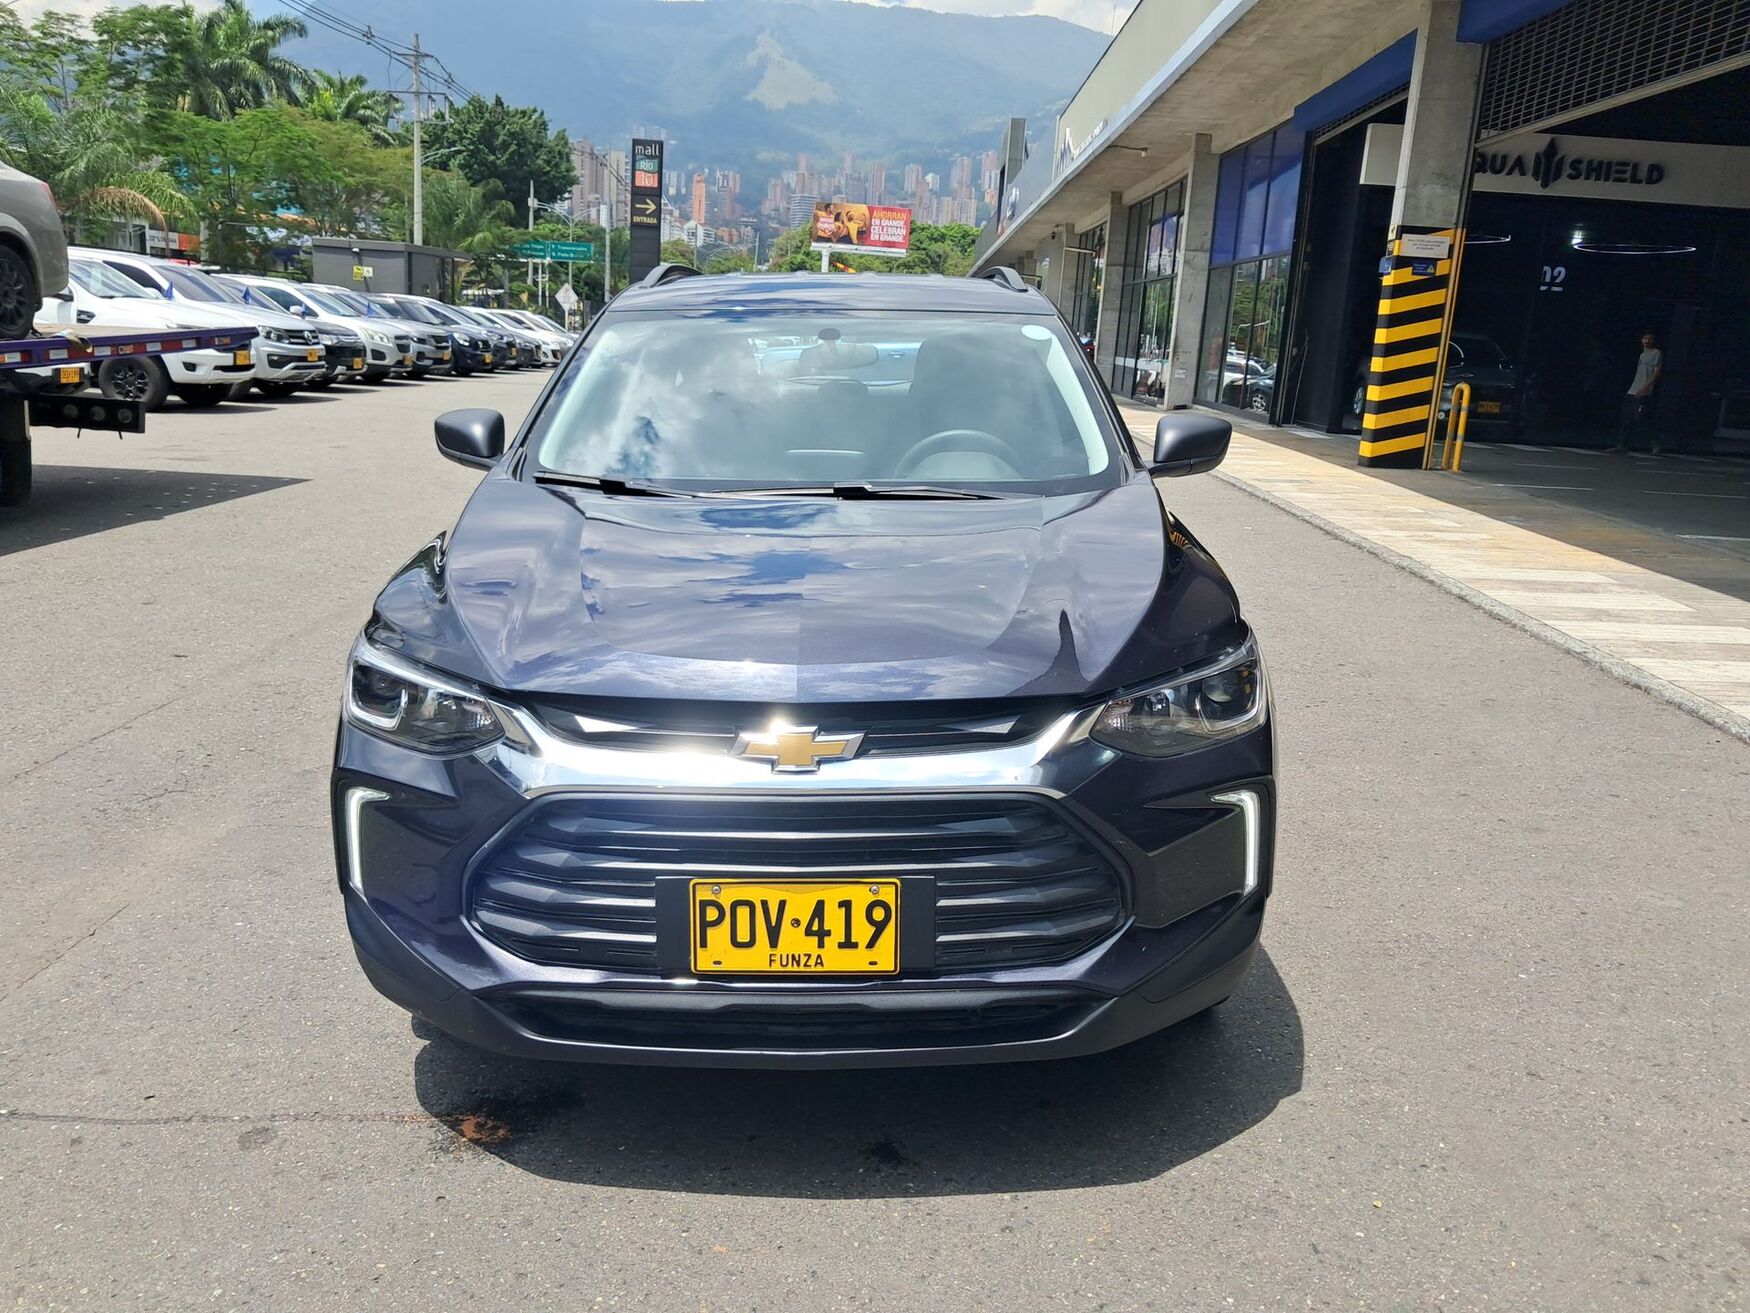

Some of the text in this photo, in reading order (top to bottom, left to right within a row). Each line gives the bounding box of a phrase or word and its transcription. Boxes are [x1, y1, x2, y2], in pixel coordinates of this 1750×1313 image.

[635, 144, 659, 156] mall
[1566, 158, 1665, 185] SHIELD
[633, 215, 658, 224] ENTRADA
[768, 953, 824, 968] FUNZA
